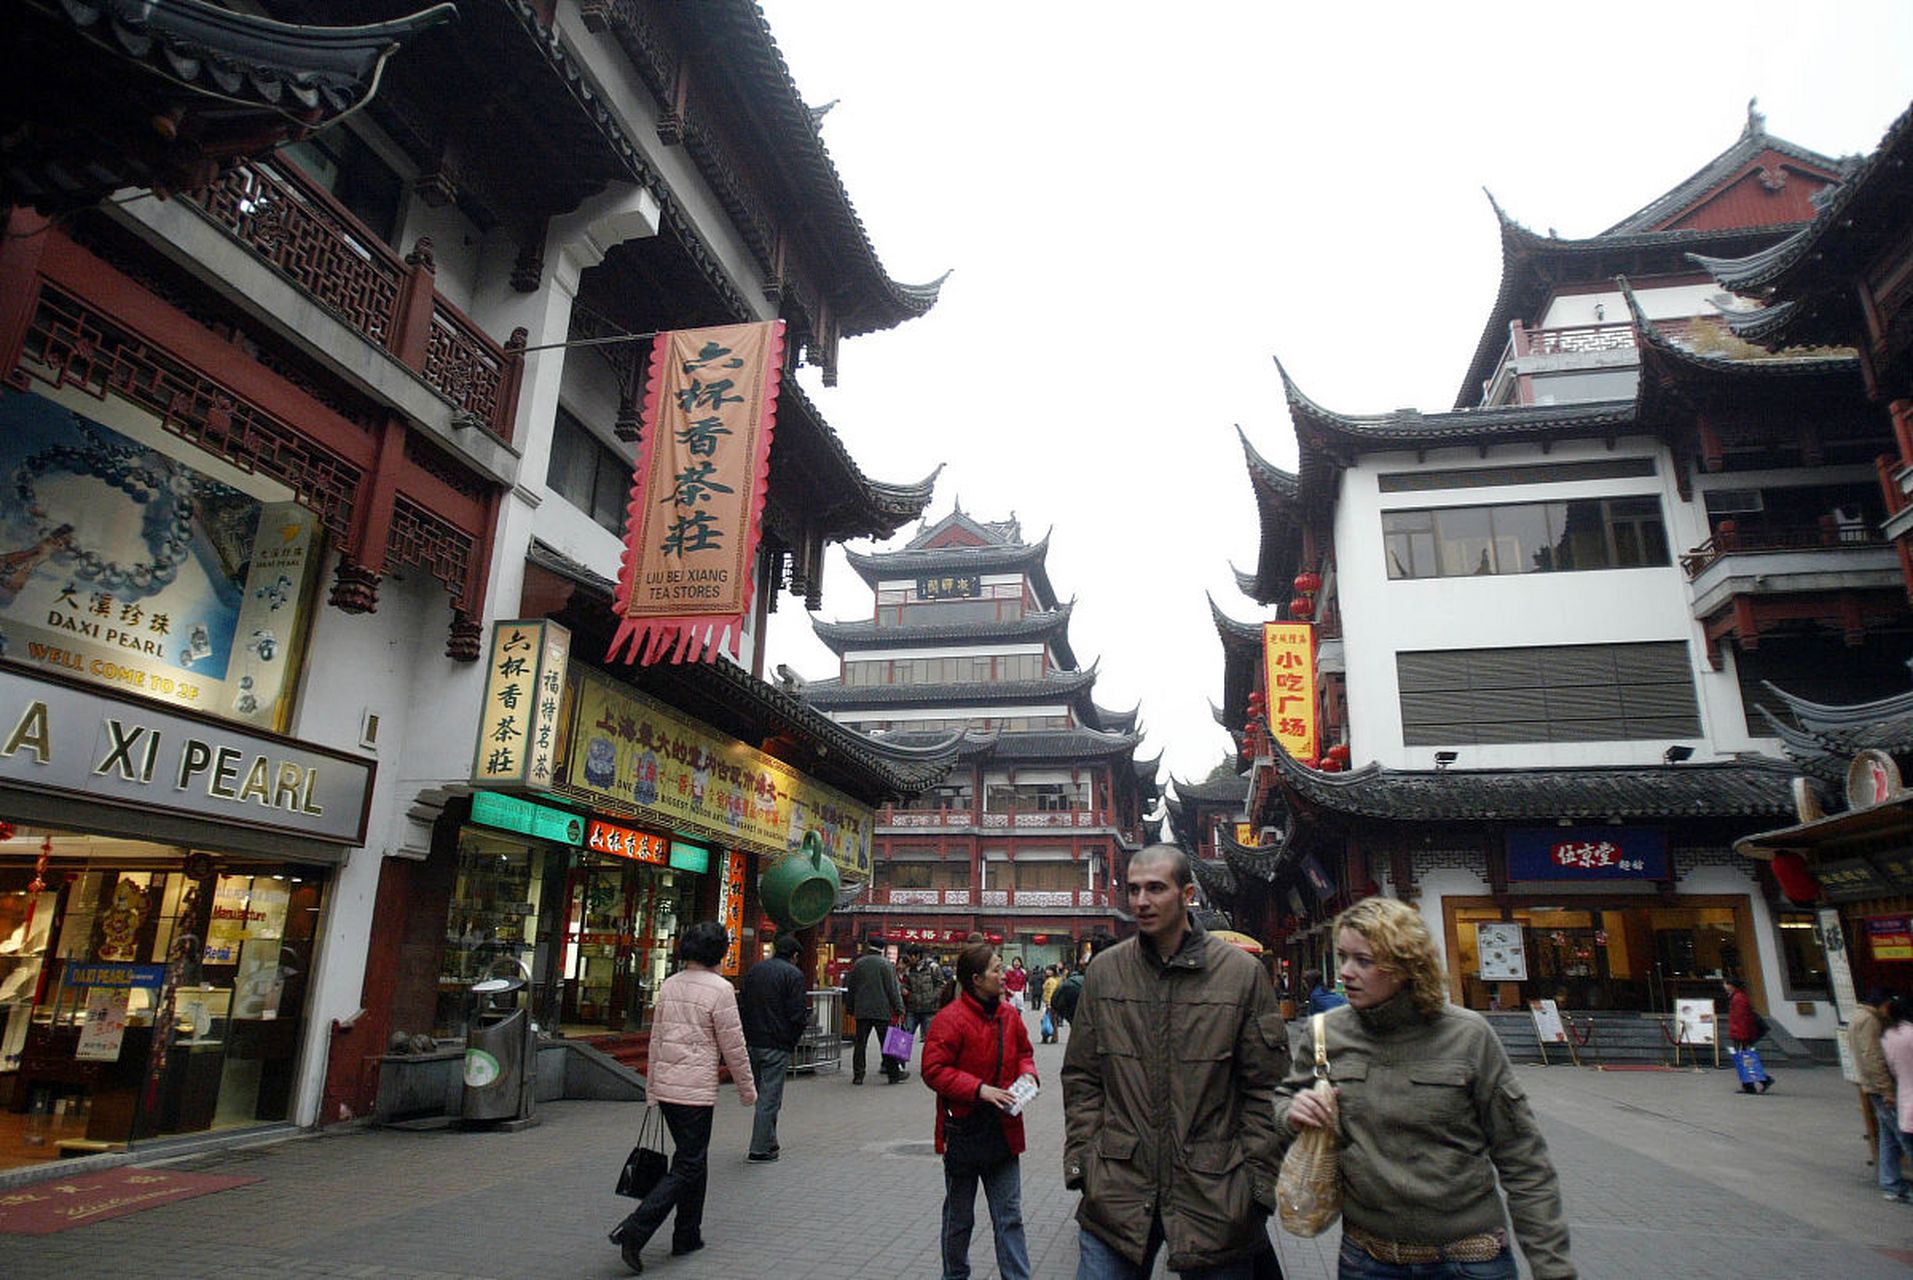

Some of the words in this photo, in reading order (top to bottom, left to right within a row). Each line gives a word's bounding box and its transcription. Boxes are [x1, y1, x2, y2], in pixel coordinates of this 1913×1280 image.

[660, 342, 745, 557] 六杯香茶莊
[646, 571, 666, 585] LIU
[666, 571, 685, 584] BEI
[686, 569, 728, 583] XIANG
[649, 587, 671, 600] TEA
[673, 585, 720, 599] STORES
[48, 611, 101, 638] DAXI
[106, 628, 166, 658] PEARL
[53, 582, 171, 636] 大溪珍珠
[28, 642, 85, 672] WELL
[90, 659, 147, 688] COME
[150, 675, 175, 694] TO
[176, 683, 200, 701] 2F
[1275, 651, 1307, 737] 小吃广场
[486, 629, 531, 775] 六杯香茶莊
[93, 719, 161, 784] XI
[176, 738, 324, 817] PEARL
